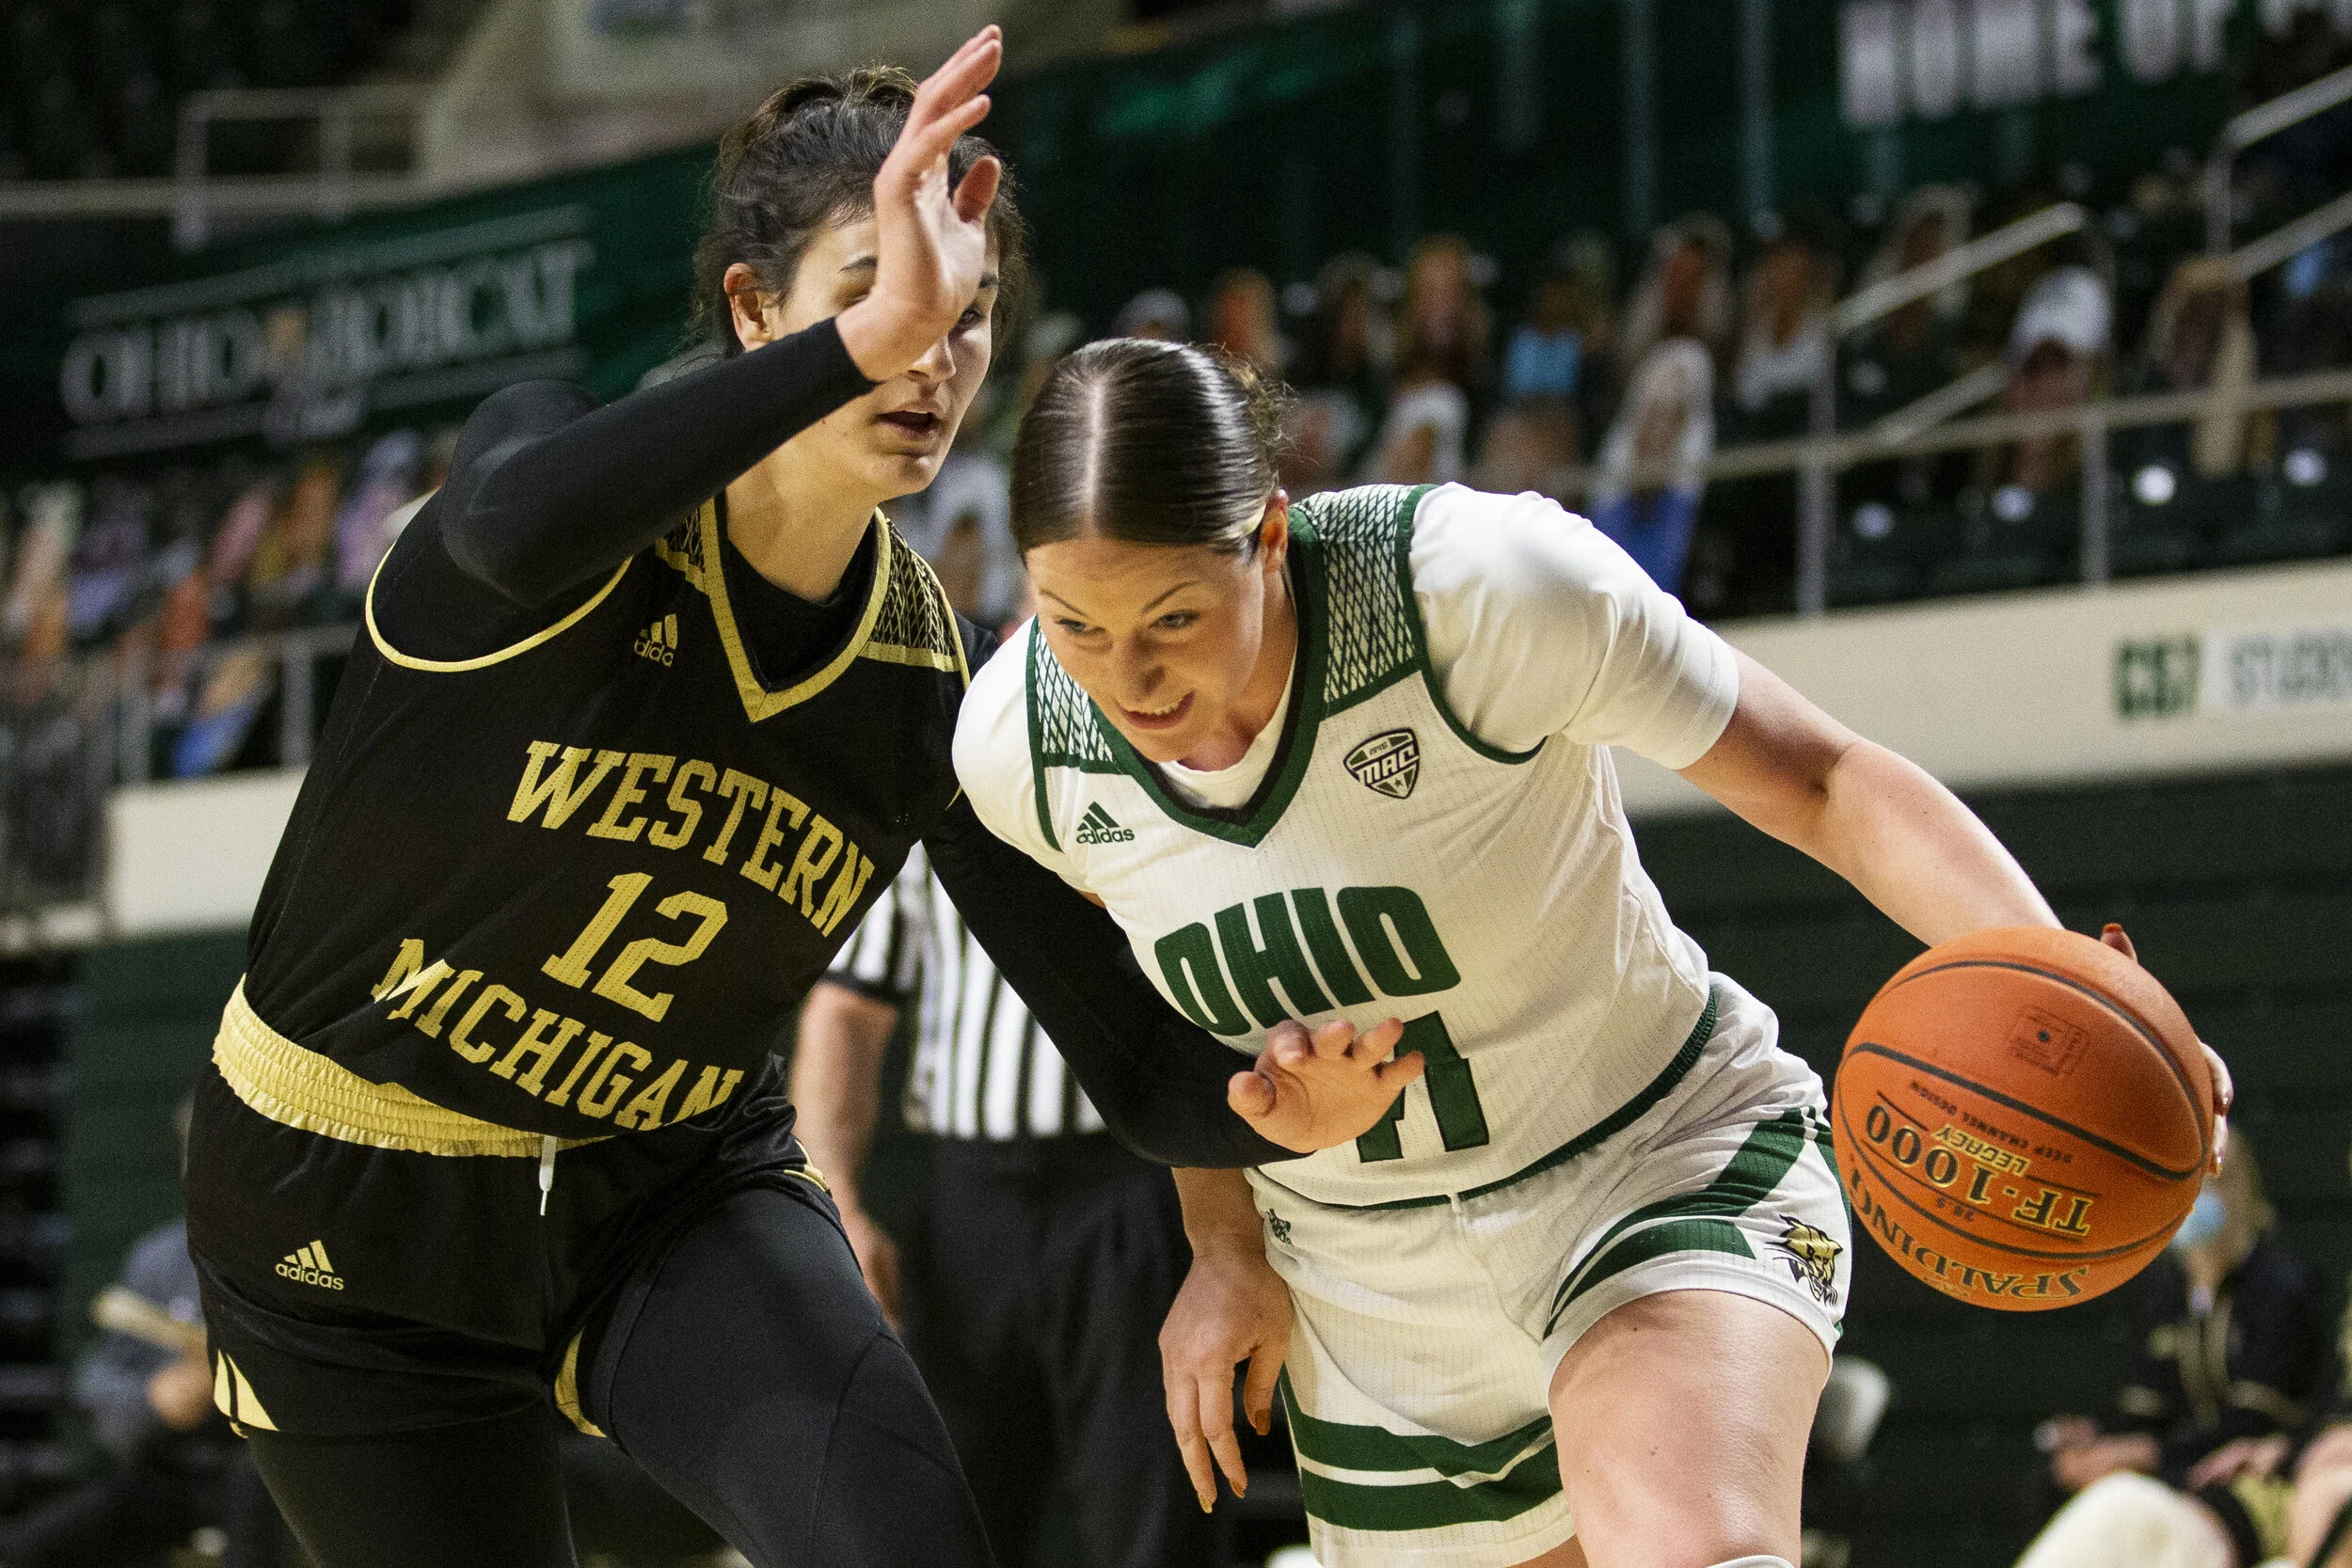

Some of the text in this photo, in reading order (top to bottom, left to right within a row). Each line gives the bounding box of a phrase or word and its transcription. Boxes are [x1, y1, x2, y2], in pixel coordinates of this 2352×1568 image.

[1354, 744, 1419, 787] MAC
[507, 740, 876, 938] WESTERN
[1075, 828, 1136, 845] adidas
[541, 872, 729, 1023] 12
[1154, 886, 1462, 1037] OHIO
[371, 938, 745, 1131] MICHIGAN
[1865, 1104, 2094, 1236] TF-1000
[1932, 1124, 2031, 1176] LEGACY
[275, 1262, 344, 1291] adidas
[1849, 1167, 2090, 1300] SPALDING
